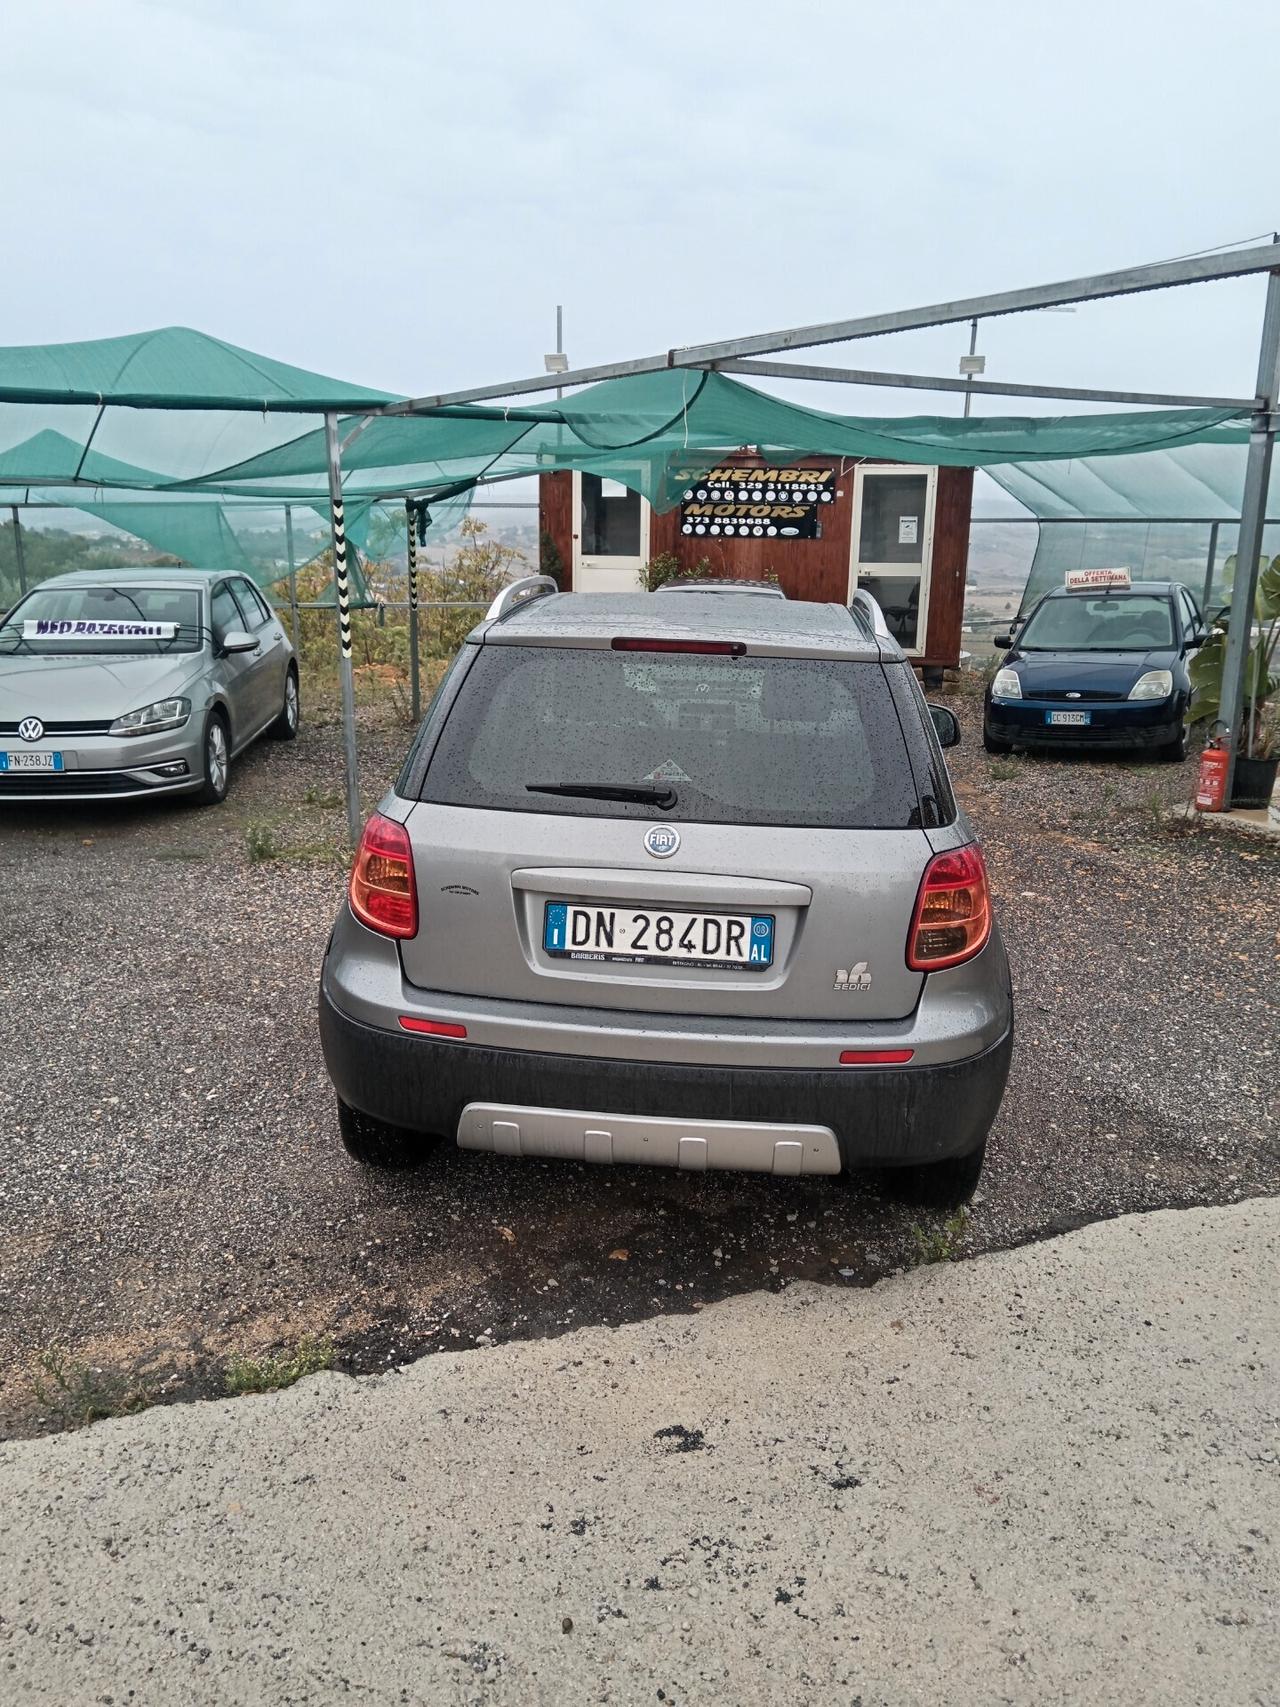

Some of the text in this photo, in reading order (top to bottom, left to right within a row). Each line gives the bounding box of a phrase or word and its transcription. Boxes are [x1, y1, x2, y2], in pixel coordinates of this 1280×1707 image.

[674, 469, 832, 483] SCHEMBRI
[707, 481, 734, 489] Cell.
[739, 482, 763, 490] 329
[767, 482, 824, 491] 3118843
[684, 503, 810, 518] MOTORS
[686, 516, 771, 525] 373 8839688
[1070, 576, 1089, 584] DELLA
[650, 833, 675, 846] FIAT
[571, 910, 746, 957] DN 284DR
[750, 943, 767, 962] AL
